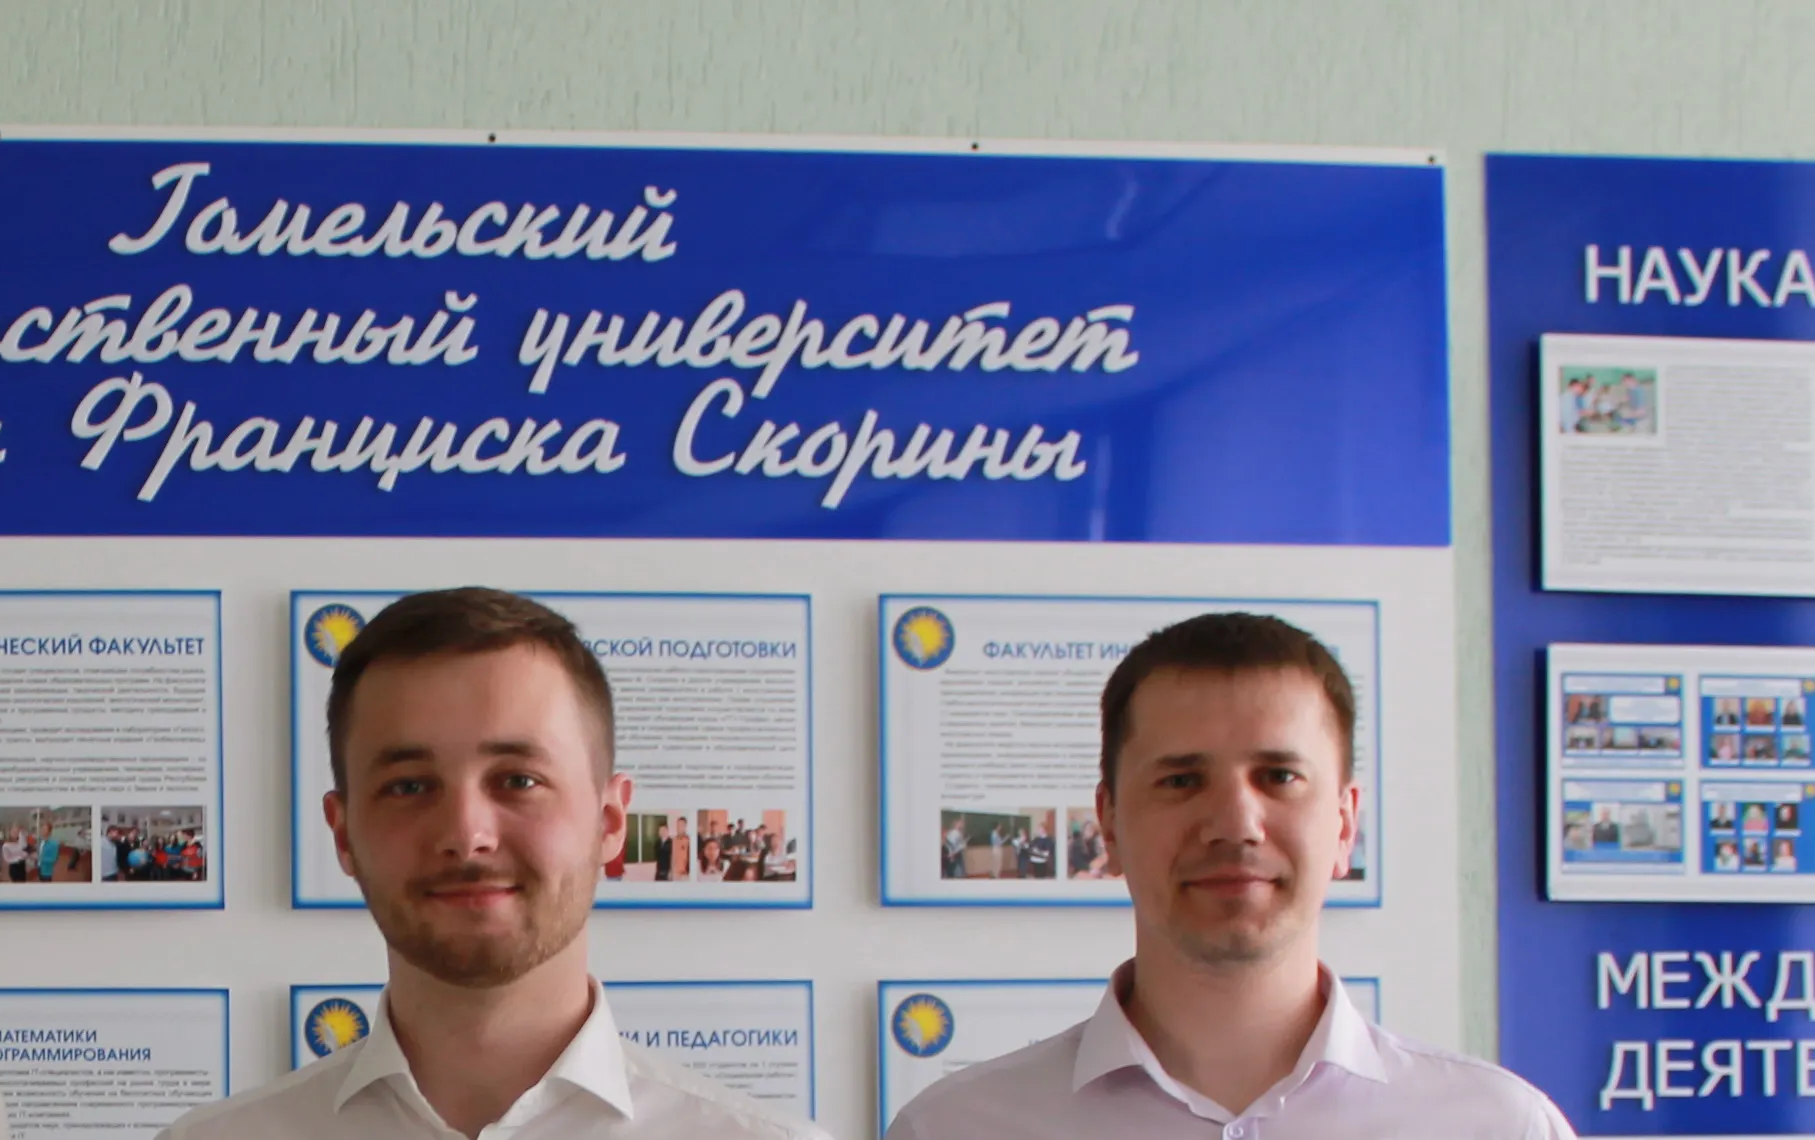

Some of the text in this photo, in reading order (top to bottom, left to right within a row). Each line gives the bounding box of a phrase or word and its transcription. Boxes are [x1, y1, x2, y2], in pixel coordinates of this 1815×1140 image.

[107, 162, 678, 261] Гомельский
[1586, 244, 1815, 308] НАУКА
[518, 289, 1139, 397] университет
[70, 371, 626, 501] Франциска
[673, 378, 1087, 508] Скорины
[88, 636, 205, 656] ФАКУЛЬТЕТ
[659, 639, 797, 660] ПОДГОТОВКИ
[983, 641, 1134, 660] ФАКУЛЬТЕТ ИН
[1597, 950, 1815, 1022] МЕЖД
[667, 1029, 799, 1050] ПЕДАГОГИКИ
